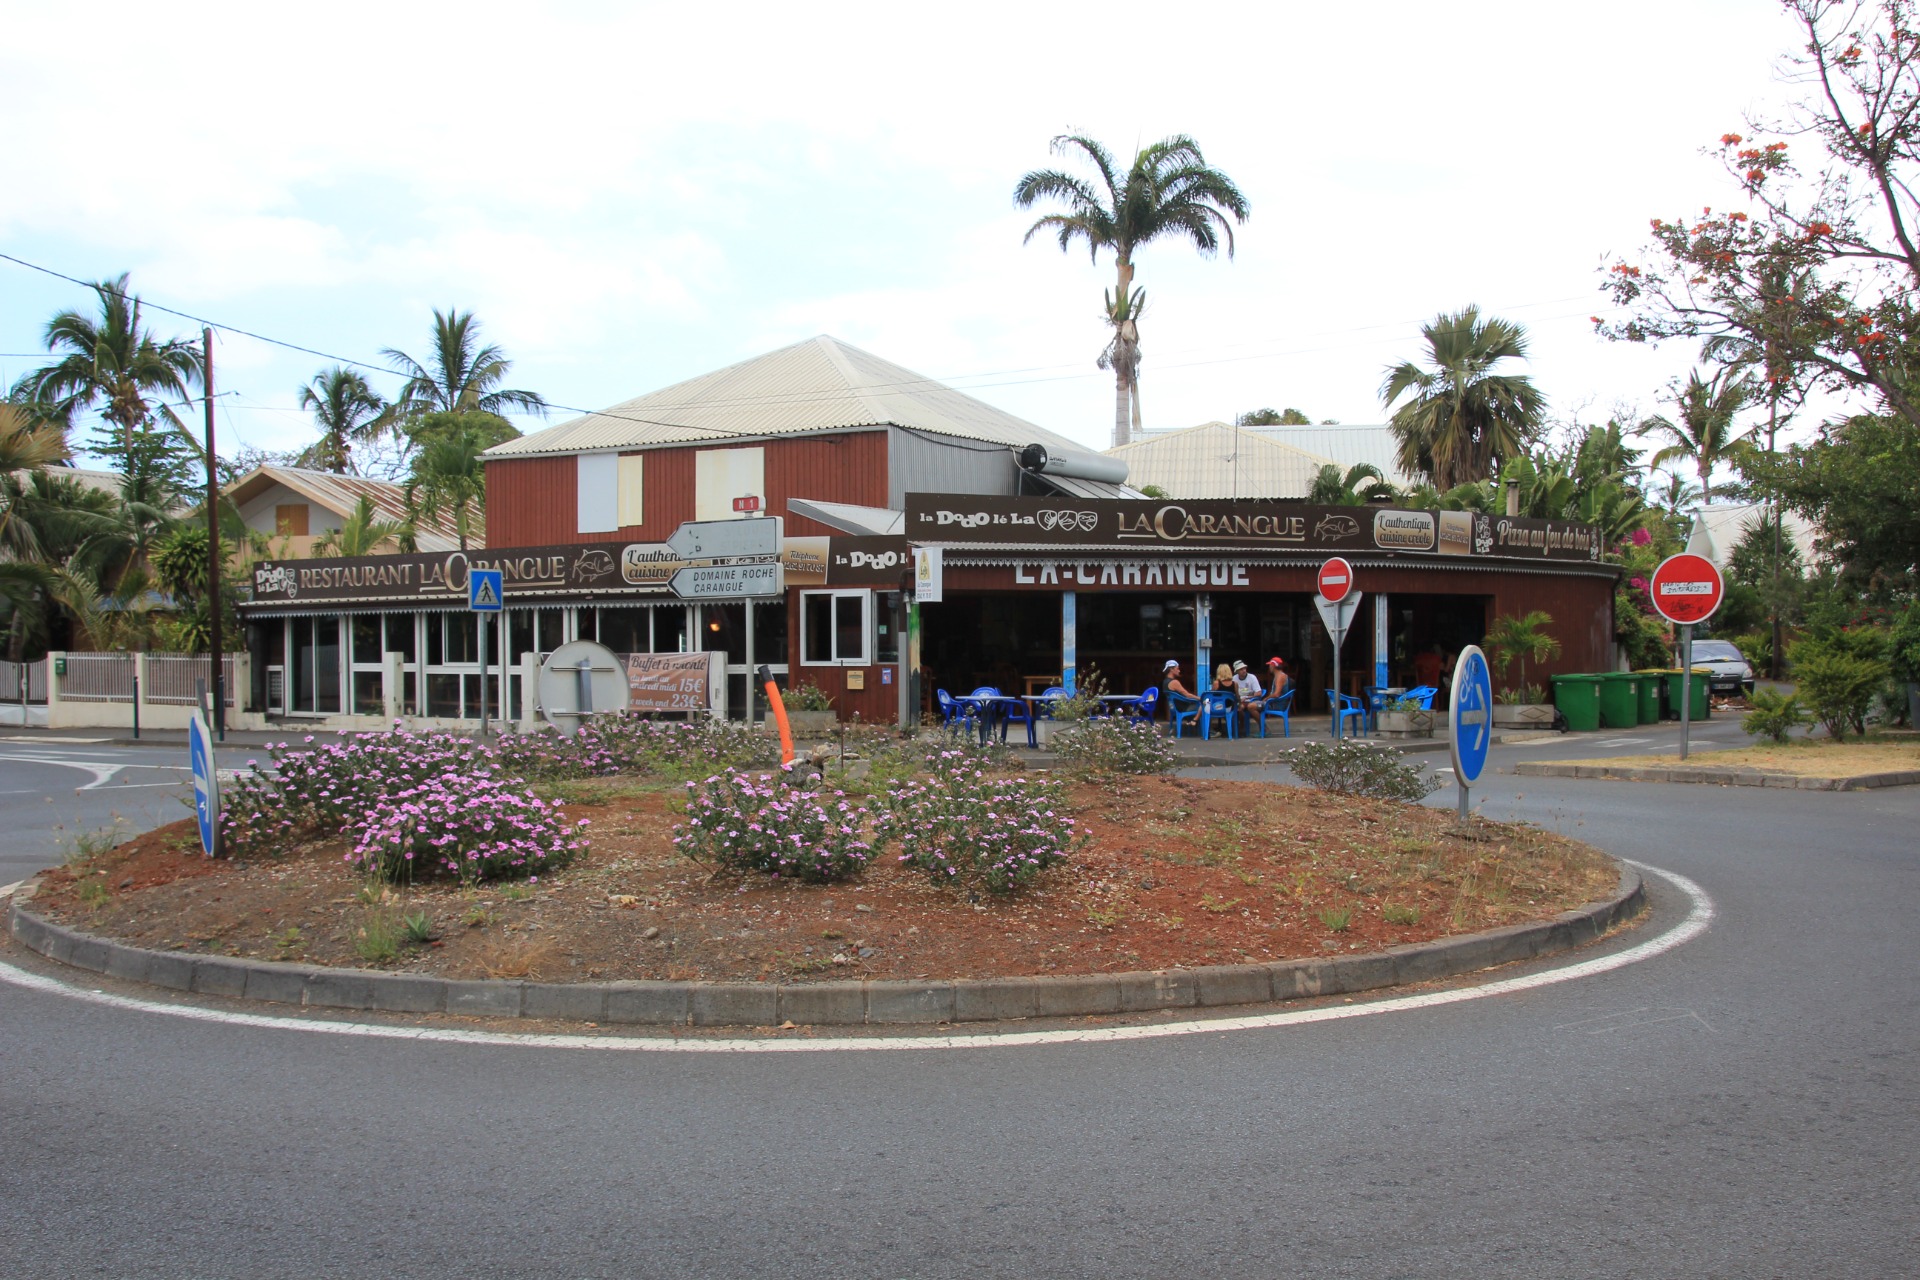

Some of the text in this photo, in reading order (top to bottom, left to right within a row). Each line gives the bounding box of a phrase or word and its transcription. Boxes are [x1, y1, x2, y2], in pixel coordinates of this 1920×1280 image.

[738, 498, 755, 510] N 1
[919, 512, 933, 522] la
[1010, 512, 1036, 525] La
[1116, 505, 1306, 541] LA CARANGUE
[1379, 530, 1407, 544] cuisine
[1497, 519, 1529, 546] Pizza
[1530, 529, 1544, 548] au
[1543, 523, 1560, 556] feu
[1562, 526, 1574, 549] de
[1575, 527, 1590, 551] bois
[836, 555, 848, 565] la
[300, 564, 413, 589] RESTAURANT
[628, 565, 670, 579] cuisine
[693, 567, 774, 582] DOMAINE ROCHE
[694, 581, 744, 593] CARANGUE
[630, 655, 661, 672] Buffet
[629, 682, 659, 691] endredi
[678, 677, 704, 693] 15€
[671, 693, 699, 708] 23€
